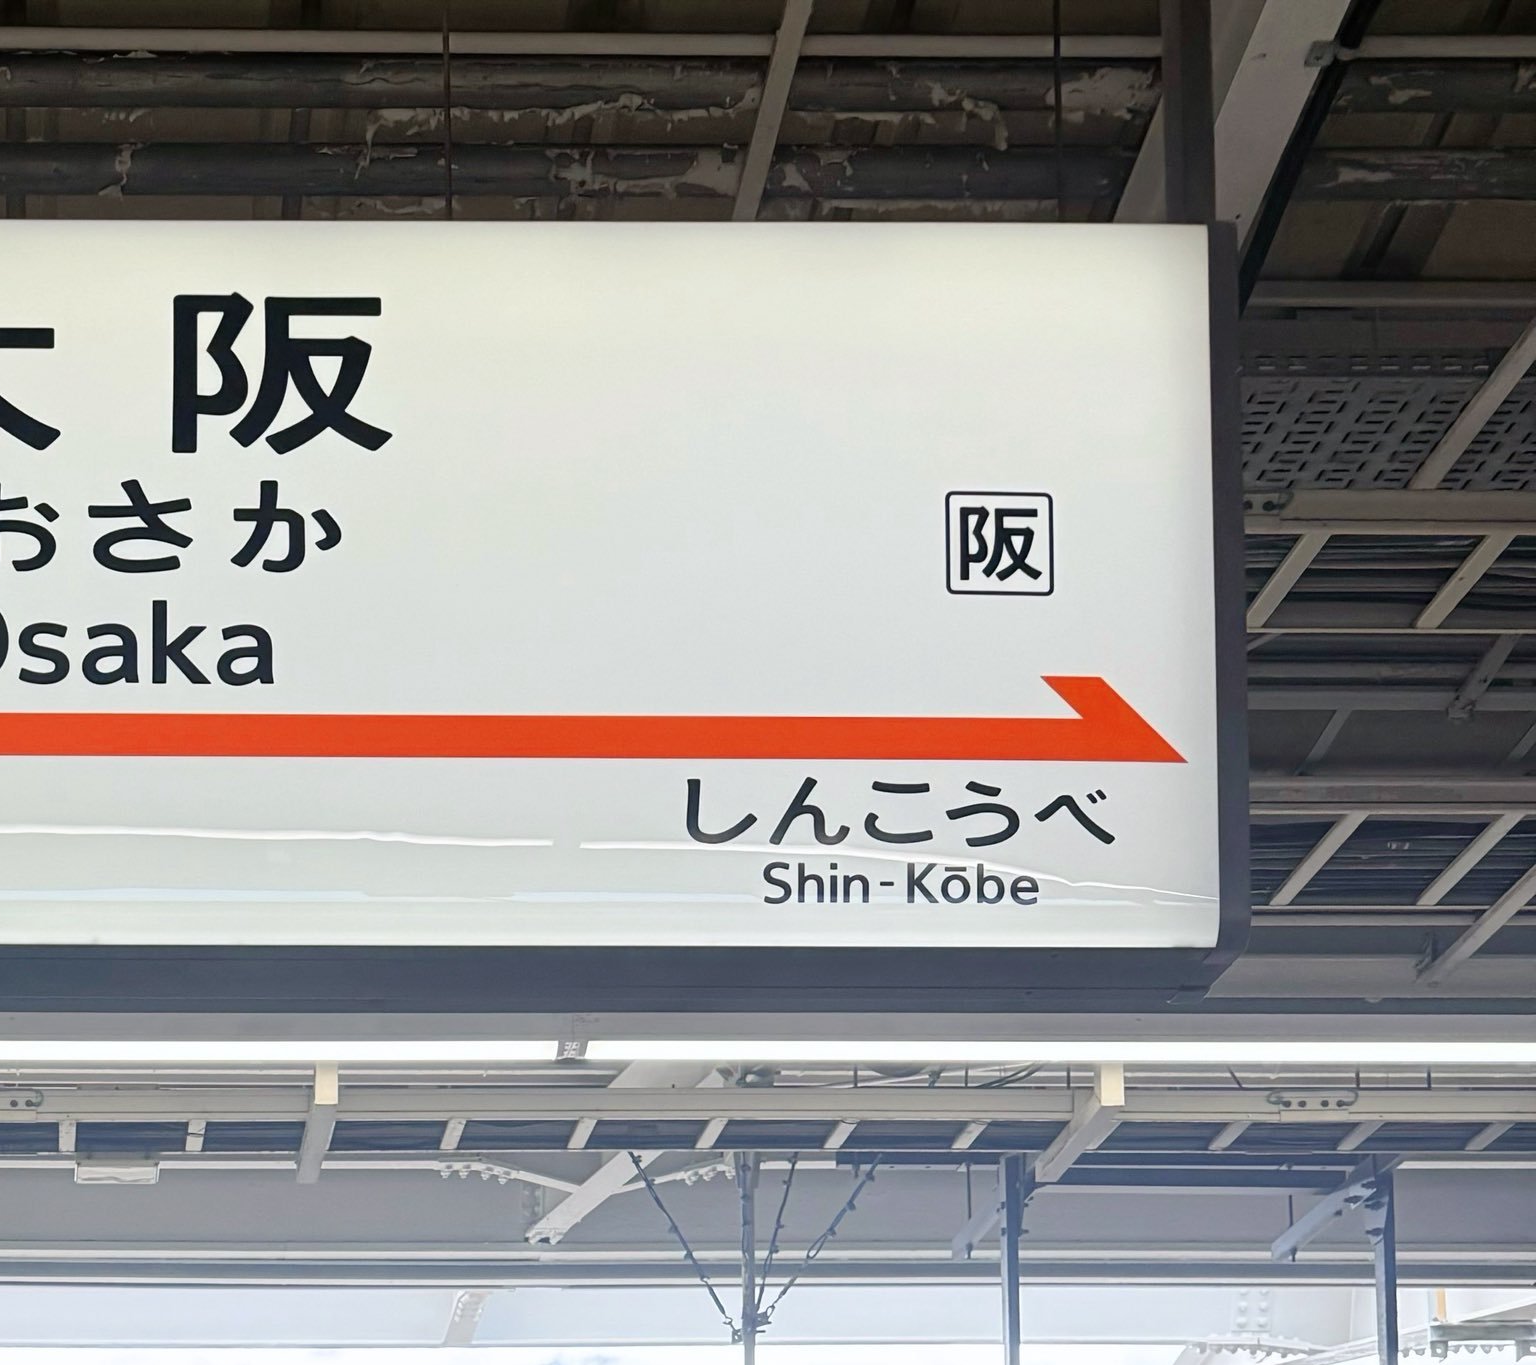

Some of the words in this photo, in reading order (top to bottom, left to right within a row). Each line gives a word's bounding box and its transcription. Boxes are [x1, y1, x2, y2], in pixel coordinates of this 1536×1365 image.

[959, 506, 1042, 582] 阪
[686, 776, 1116, 848] しんこうべ
[763, 861, 1039, 905] Shin-Kōbe
